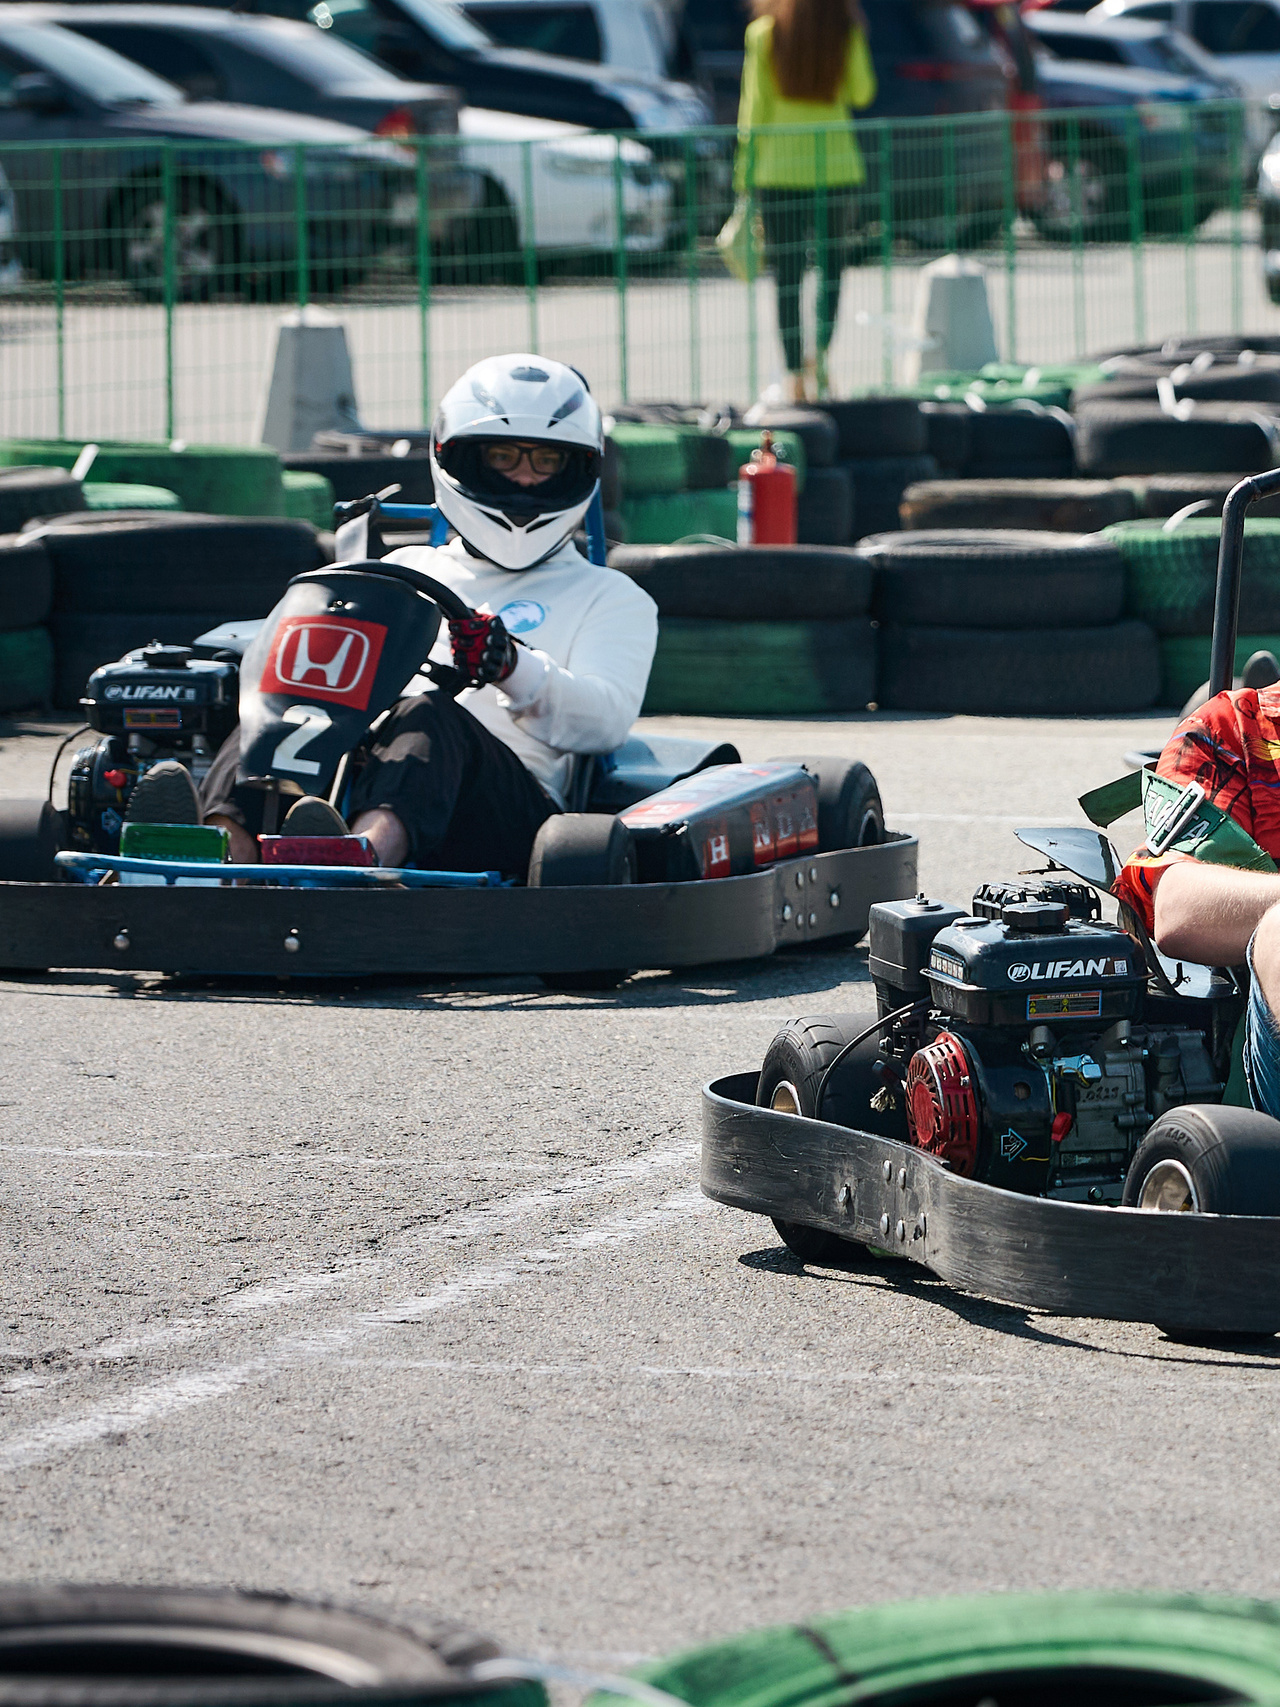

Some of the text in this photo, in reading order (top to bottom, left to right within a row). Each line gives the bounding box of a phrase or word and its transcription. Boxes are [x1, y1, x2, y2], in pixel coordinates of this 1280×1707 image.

[121, 685, 182, 700] LIFAN
[271, 704, 333, 777] 2
[1030, 958, 1107, 980] LIFAN
